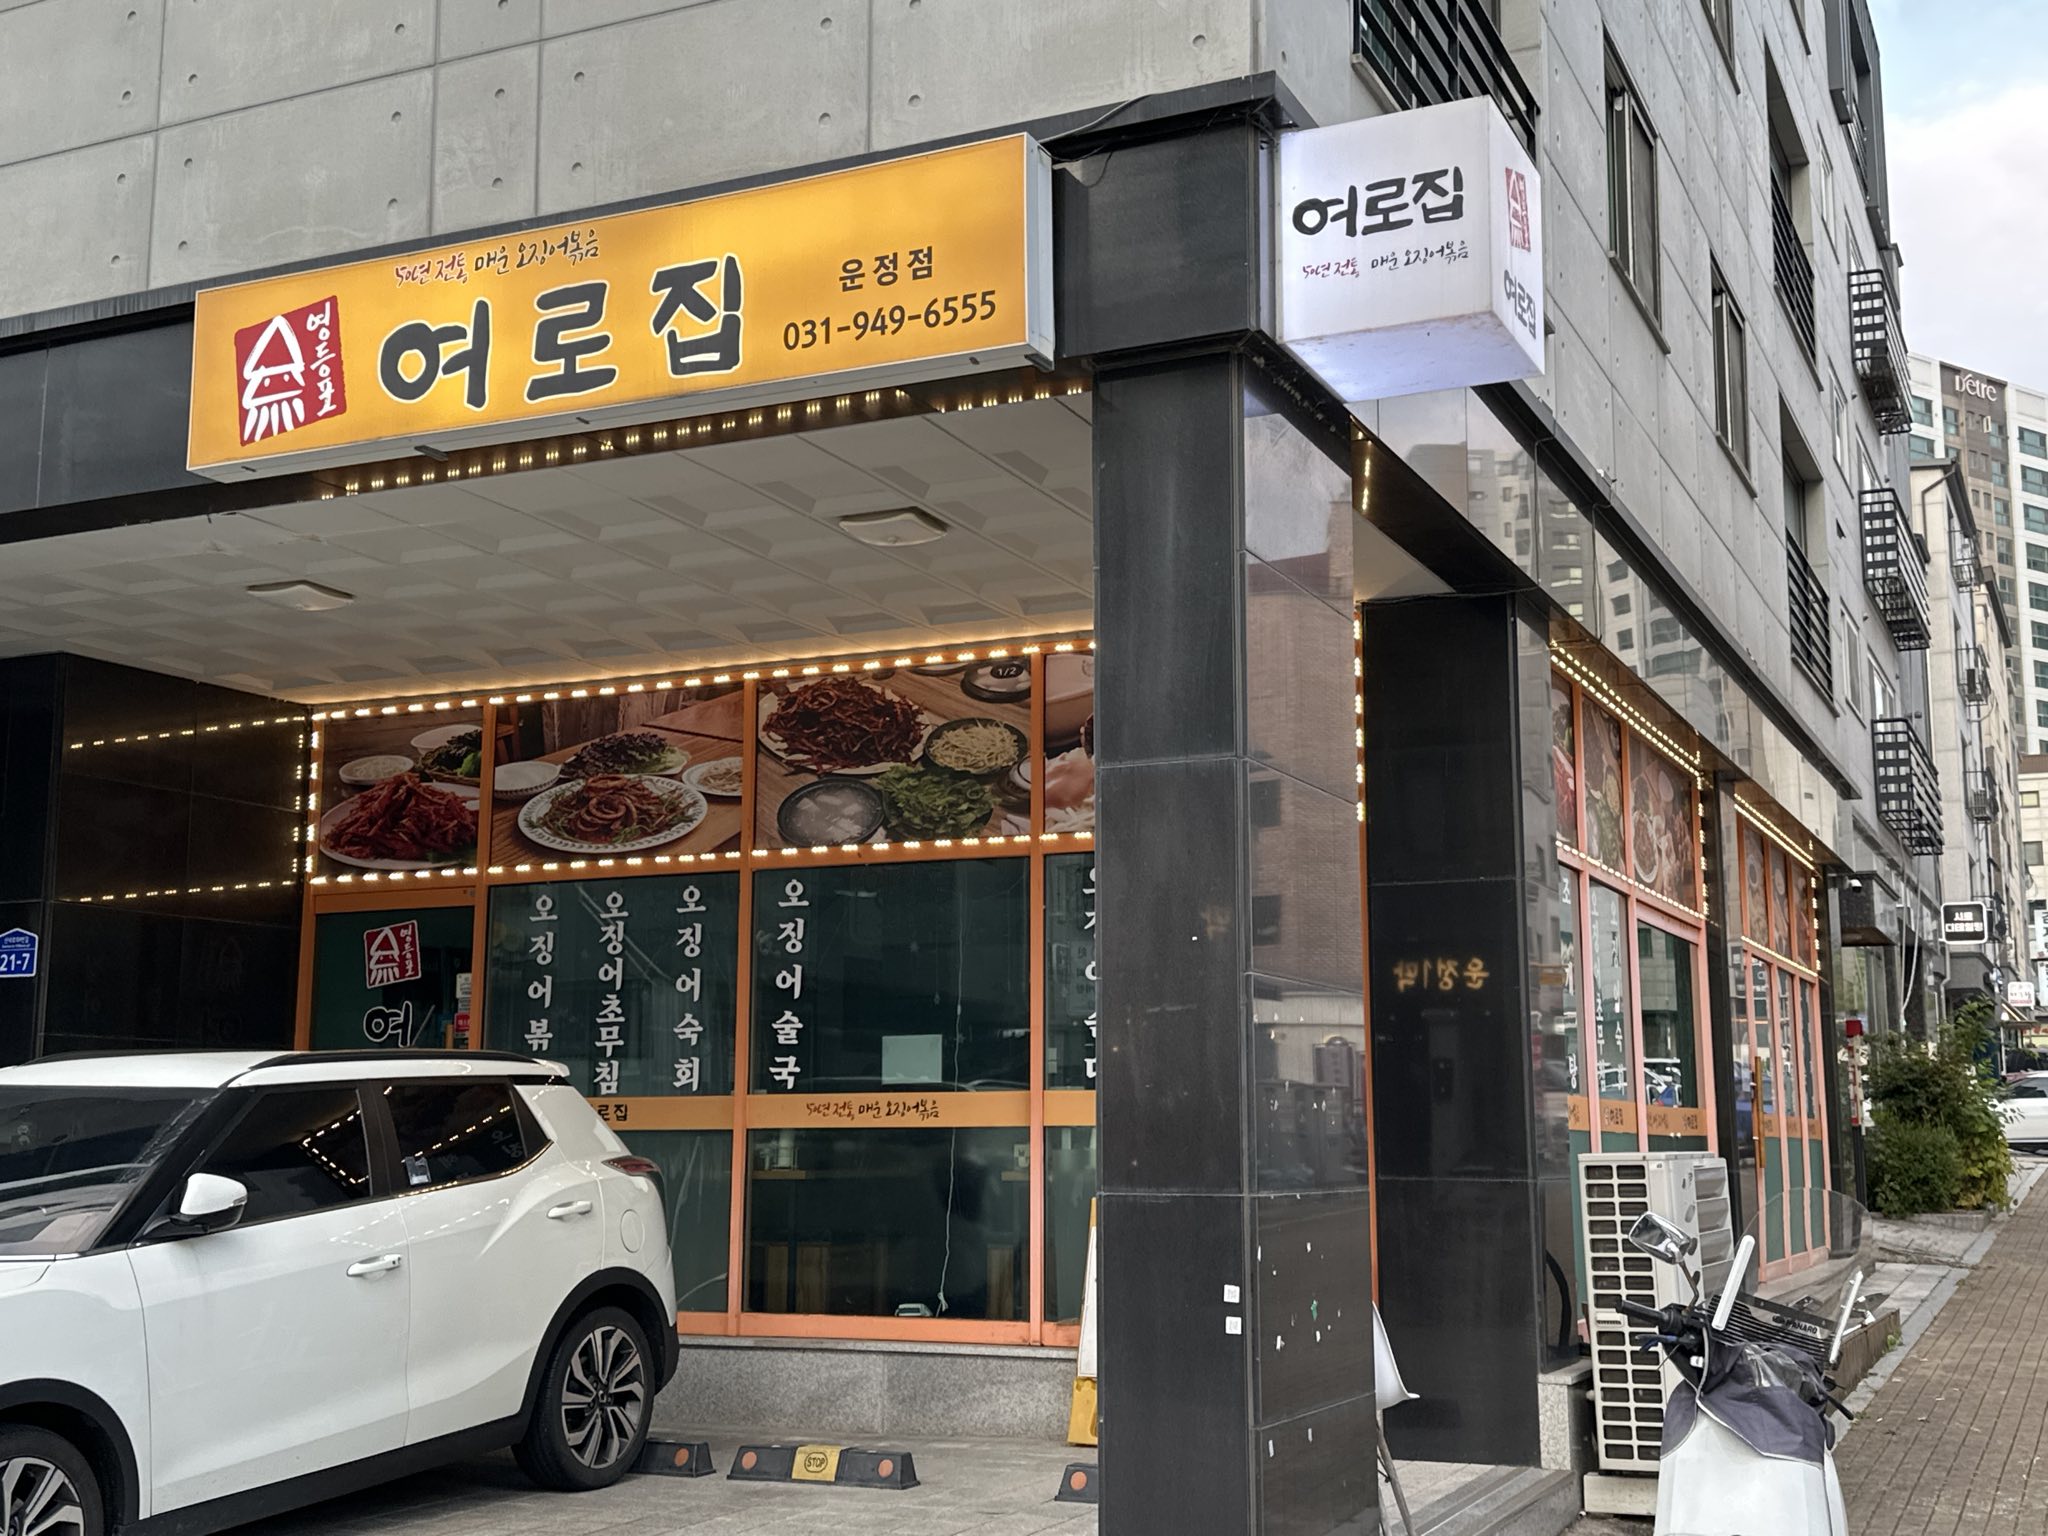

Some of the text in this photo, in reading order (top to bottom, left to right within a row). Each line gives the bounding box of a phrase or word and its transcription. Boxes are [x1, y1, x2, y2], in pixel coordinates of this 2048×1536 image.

[1292, 166, 1464, 237] 여로집
[396, 229, 599, 287] 50년 전통 매운 오징어볶음
[838, 246, 934, 292] 운정점
[1302, 240, 1469, 279] 50년 전통 매운 오징어볶음
[379, 253, 743, 411] 여로집
[783, 290, 997, 351] 031-949-6555
[1504, 269, 1536, 339] 여로집
[306, 301, 337, 417] 영등포
[998, 667, 1017, 676] 1/2
[0, 953, 31, 971] 21-7
[400, 924, 415, 977] 영등포
[524, 894, 560, 1051] 오징어볶
[593, 891, 629, 1095] 오징어초무침
[672, 885, 707, 1091] 오징어숙회
[768, 879, 810, 1090] 오징어술국
[363, 1000, 413, 1049] 여
[597, 1103, 628, 1121] 로집
[806, 1098, 940, 1121] 50년 전통 매운 오징어볶음
[806, 1456, 826, 1468] STOP
